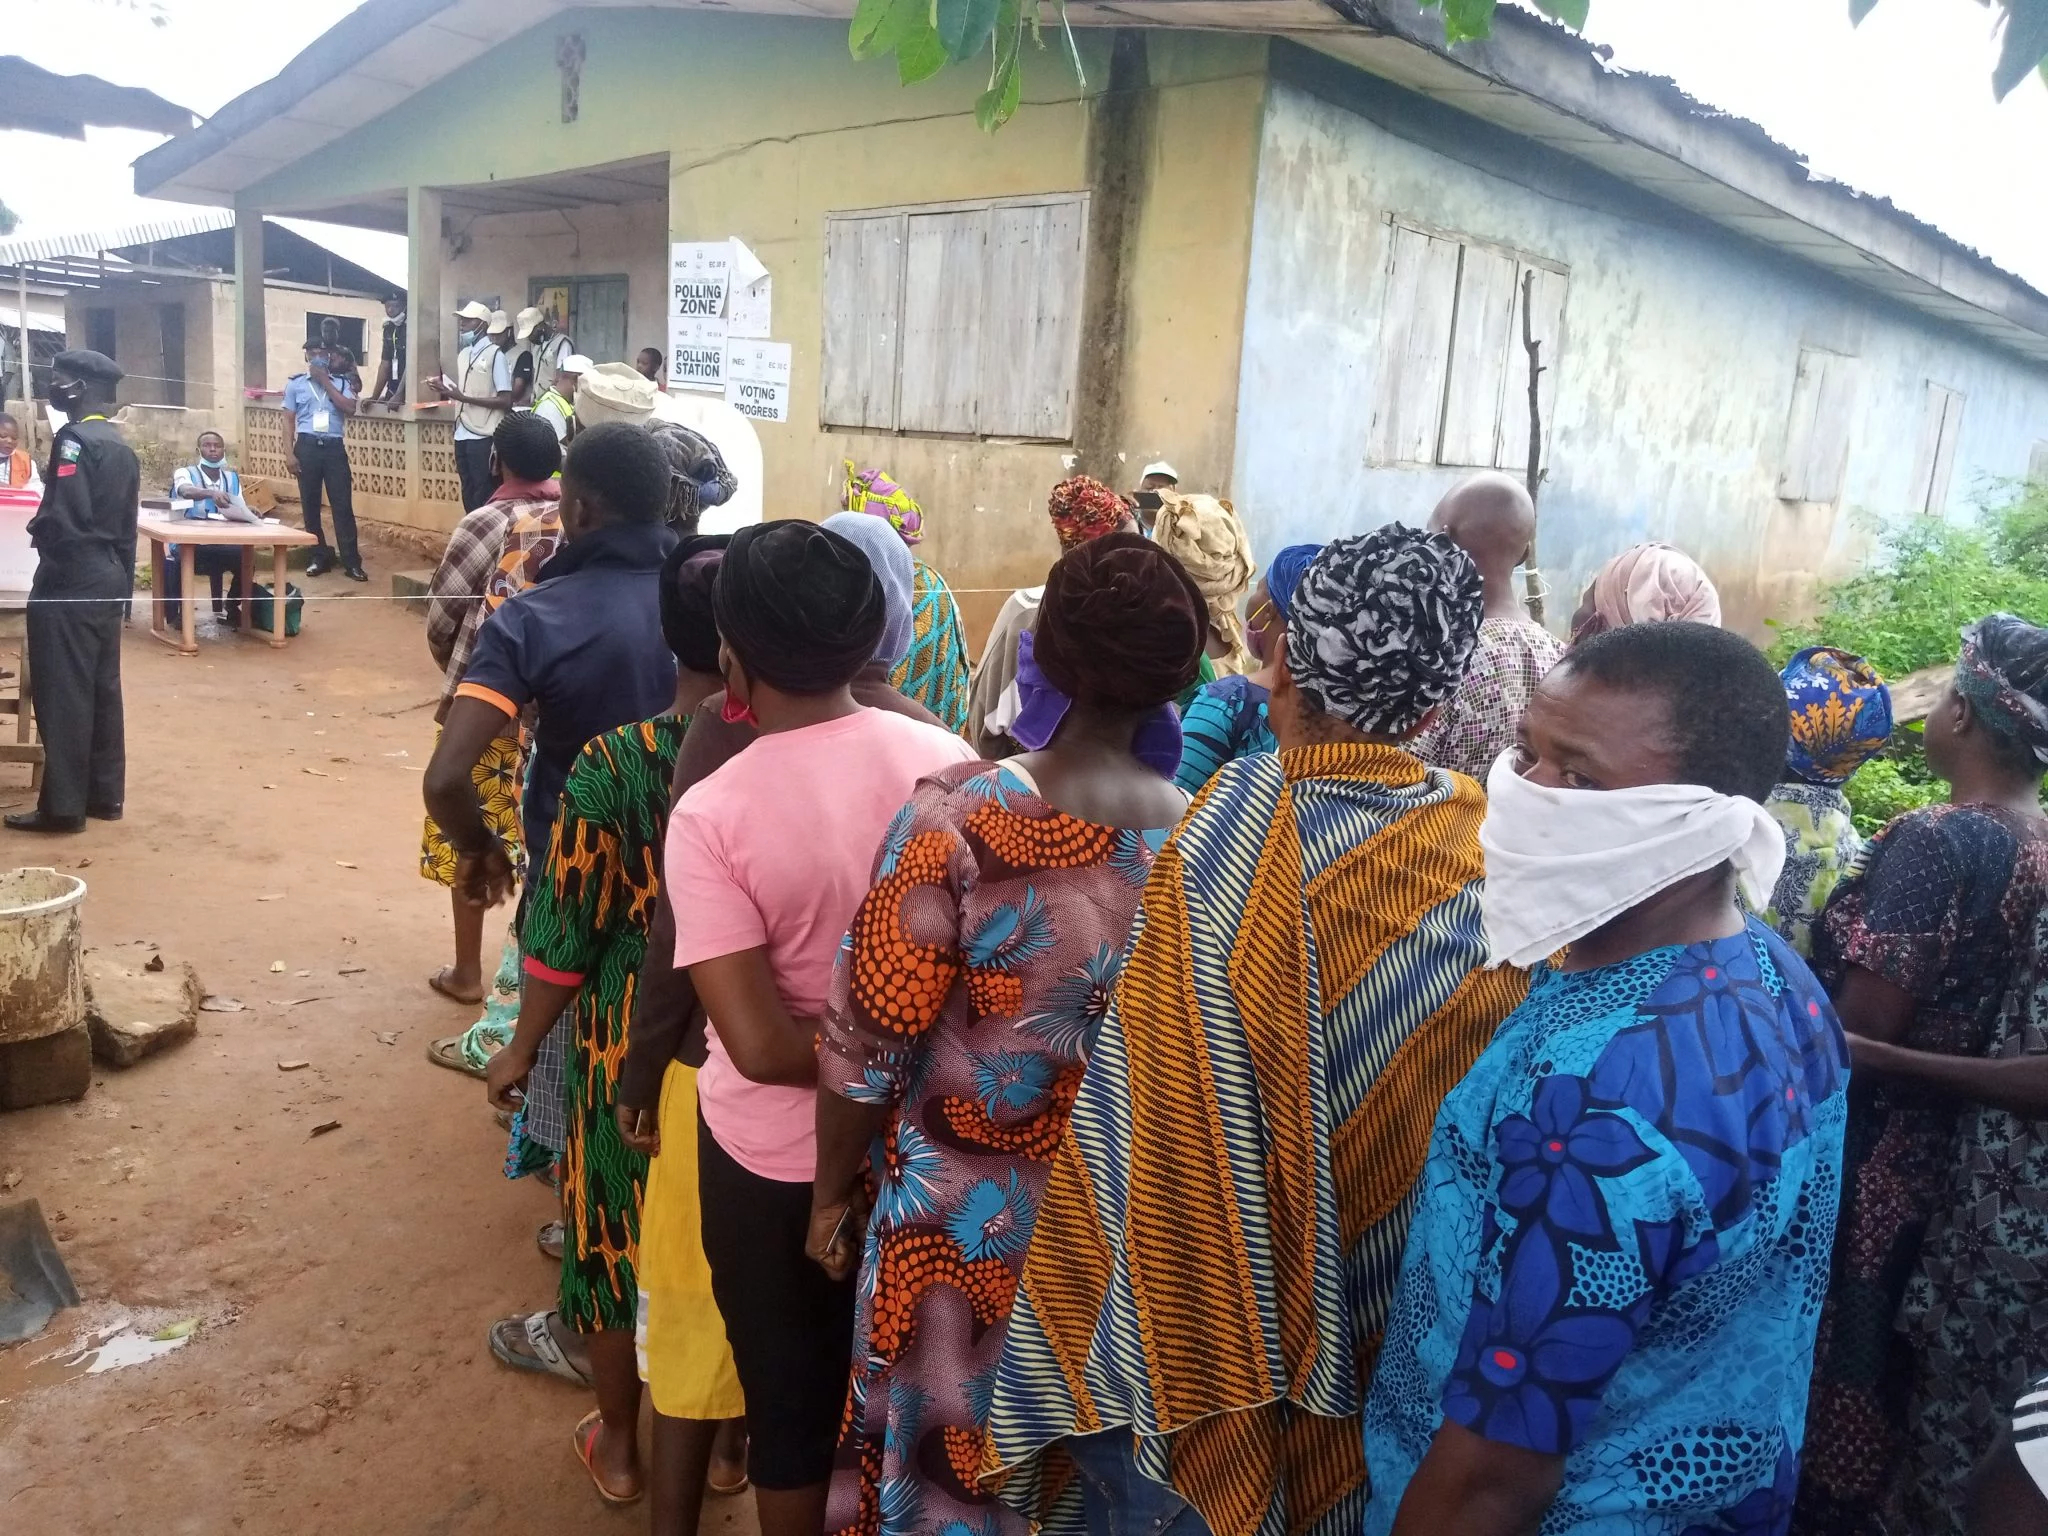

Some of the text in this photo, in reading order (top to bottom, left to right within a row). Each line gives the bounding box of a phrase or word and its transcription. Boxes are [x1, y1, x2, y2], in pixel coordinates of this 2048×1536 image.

[675, 284, 722, 299] POLLING
[680, 299, 717, 314] ZONE
[676, 349, 720, 364] POLLING
[676, 362, 720, 378] STATION
[739, 384, 776, 400] VOTING
[734, 403, 779, 419] PROGRESS
